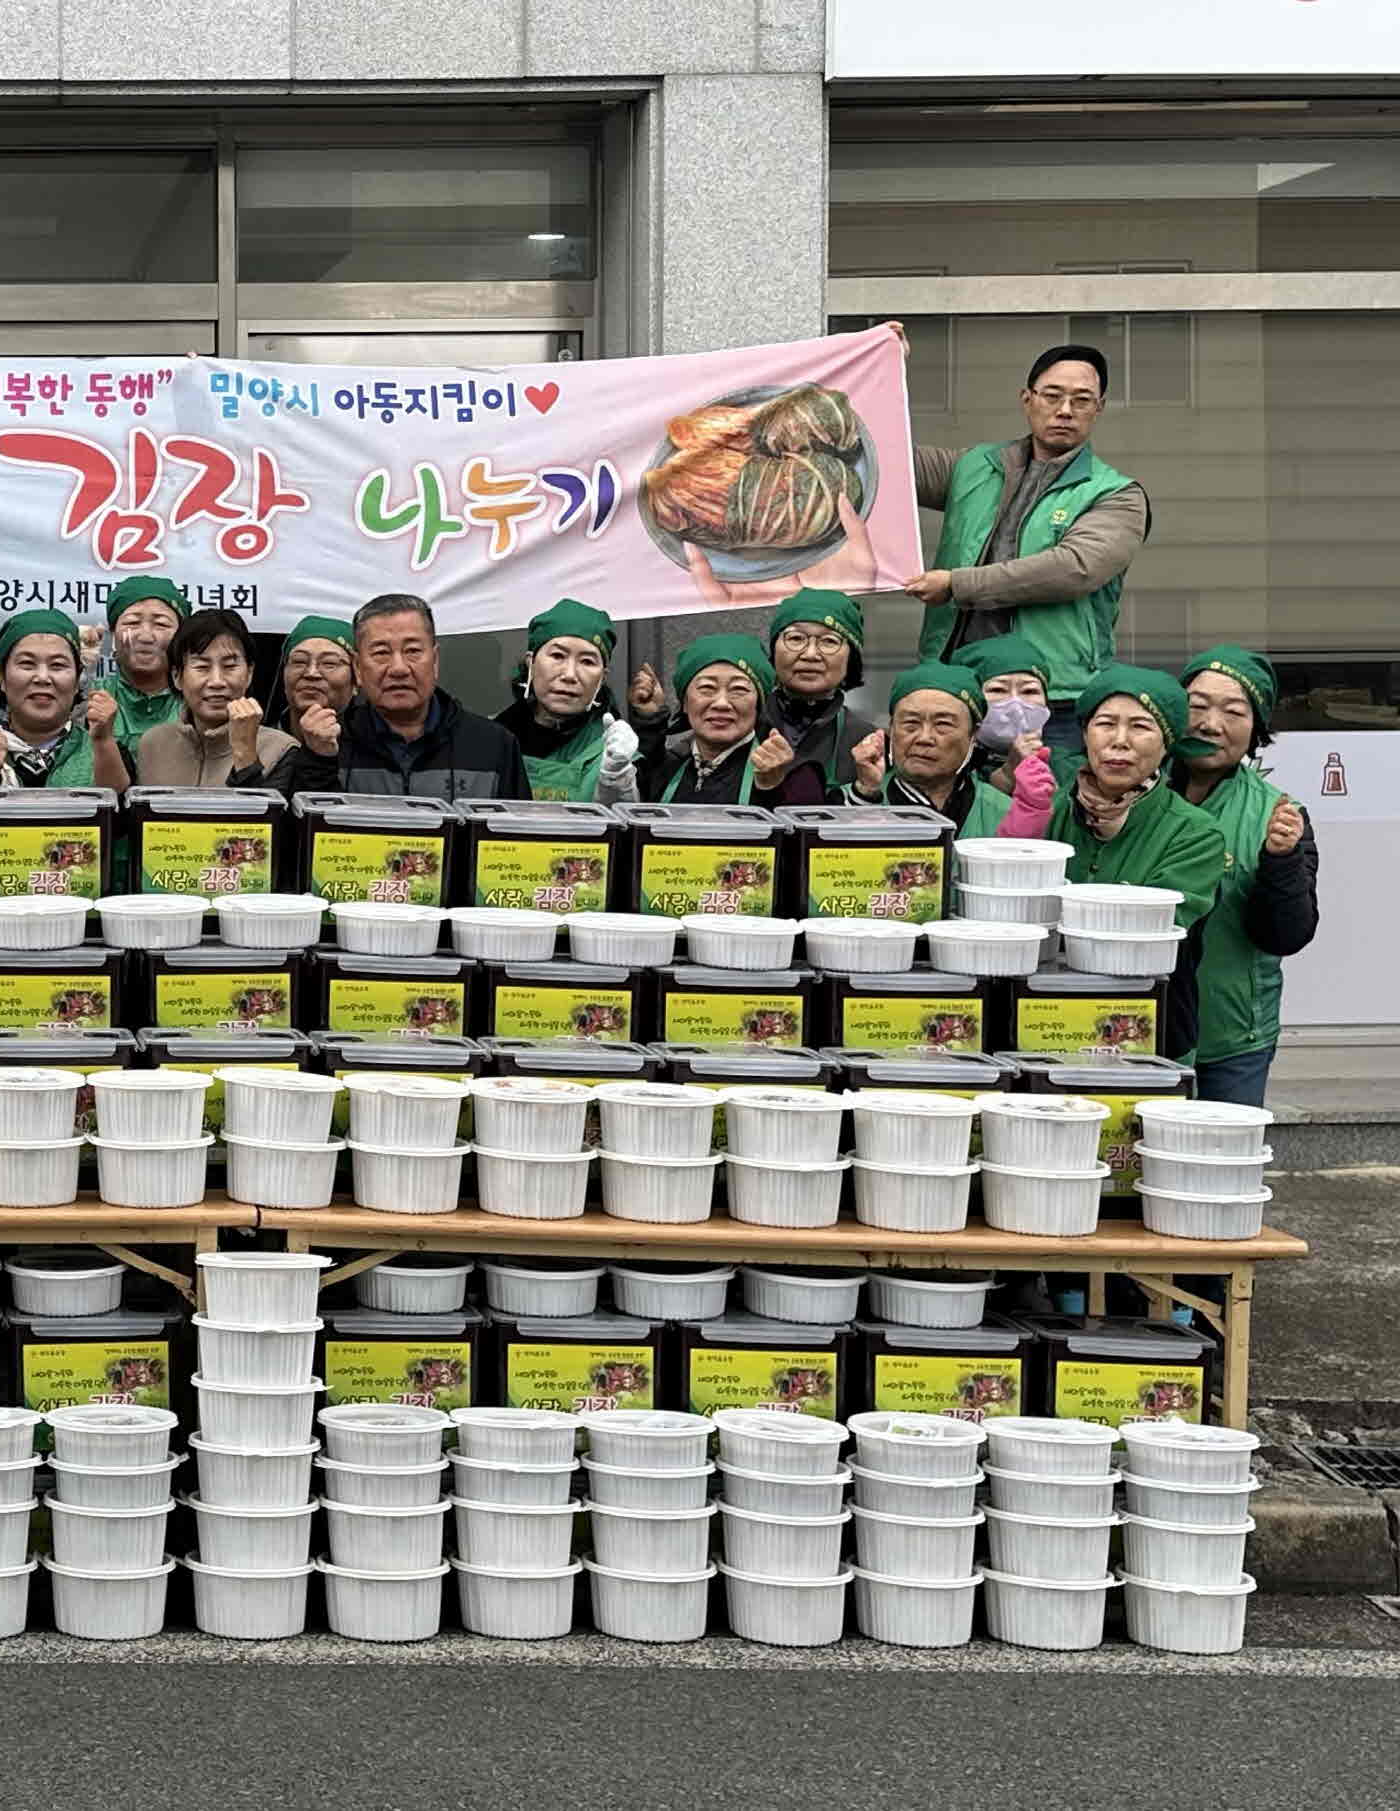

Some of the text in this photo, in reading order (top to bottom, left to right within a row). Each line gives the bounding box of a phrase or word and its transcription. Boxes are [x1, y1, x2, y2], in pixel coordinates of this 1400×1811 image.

[209, 371, 321, 420] 밀양시
[333, 379, 517, 424] 아동지킴이
[359, 461, 617, 565] 나누기
